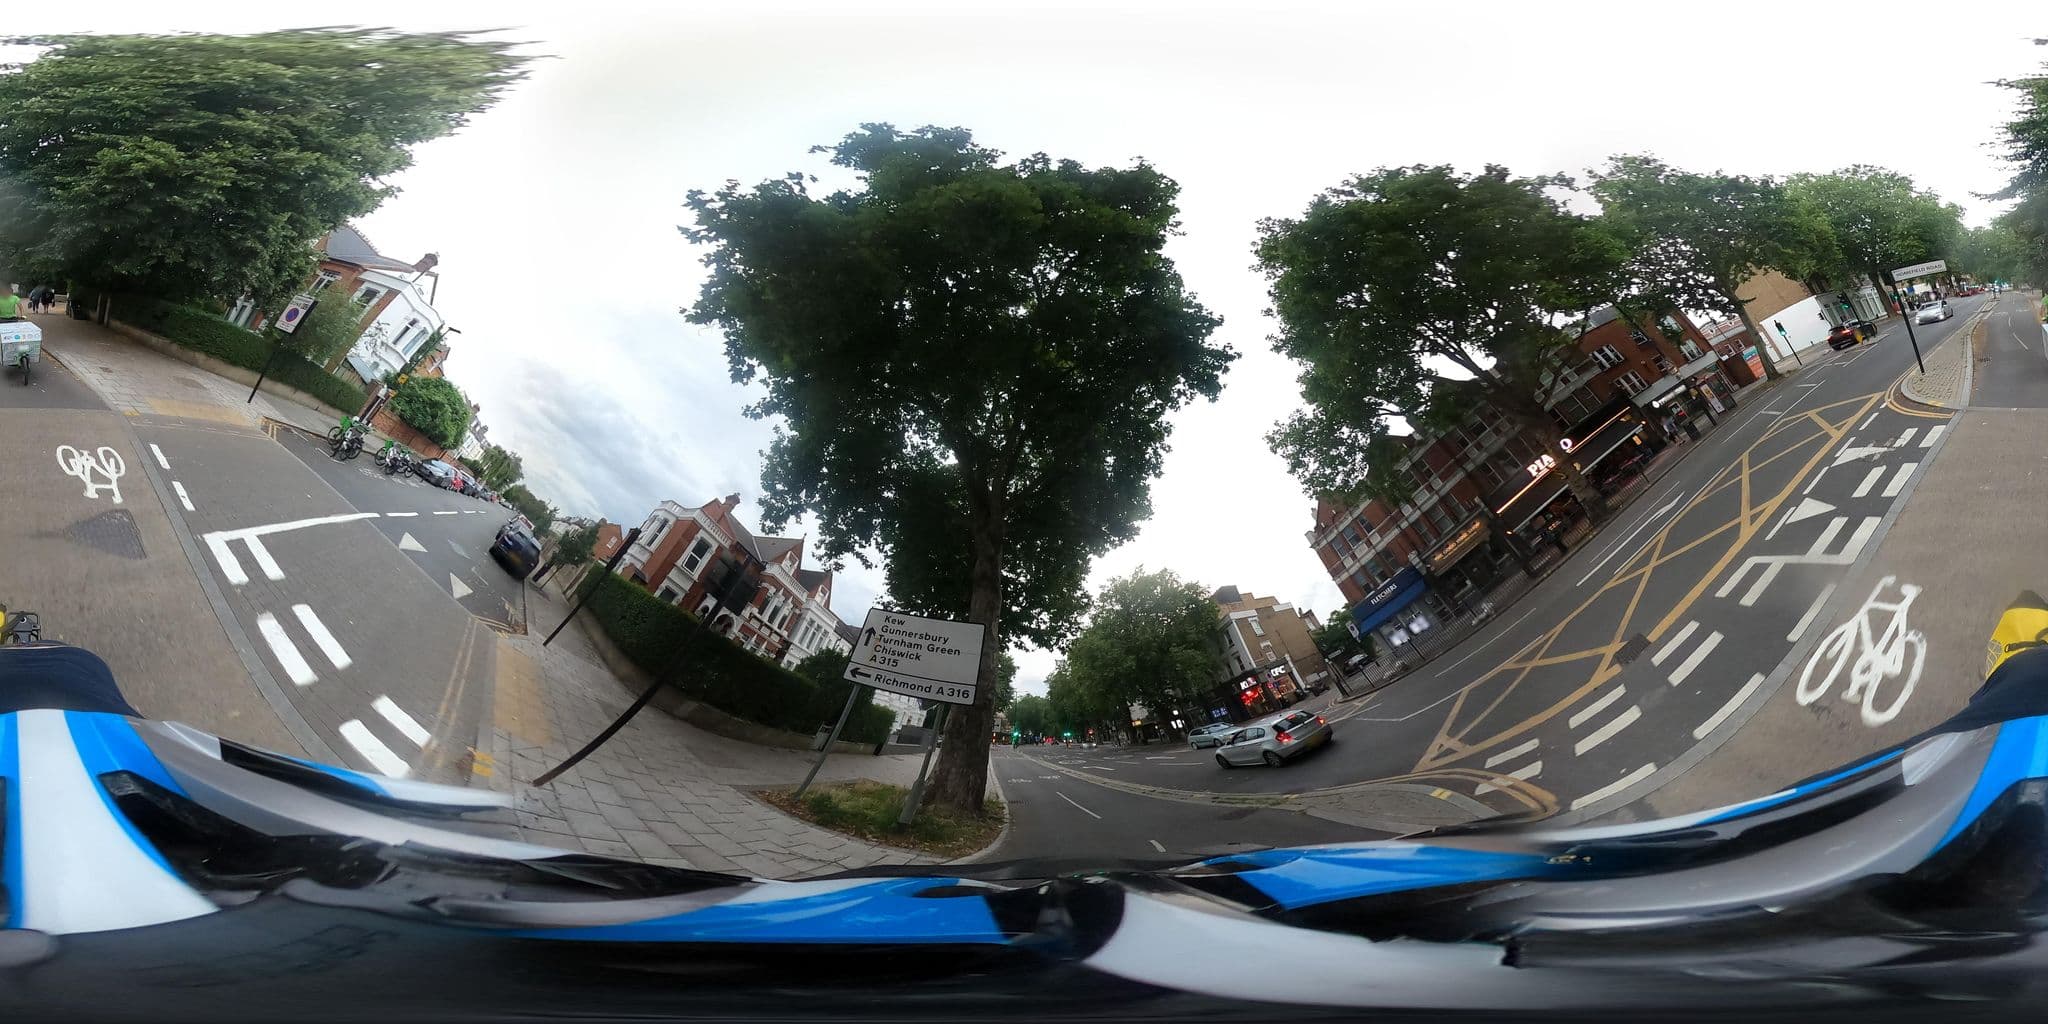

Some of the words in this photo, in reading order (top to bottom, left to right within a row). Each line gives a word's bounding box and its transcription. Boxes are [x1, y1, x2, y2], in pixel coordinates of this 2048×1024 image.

[1526, 438, 1573, 478] PIAO
[884, 615, 906, 626] Kew
[878, 634, 922, 651] Turnham
[927, 644, 961, 656] Green
[881, 625, 949, 645] Gunnersbury
[874, 644, 922, 661] Chiswick
[874, 673, 932, 693] Richmond
